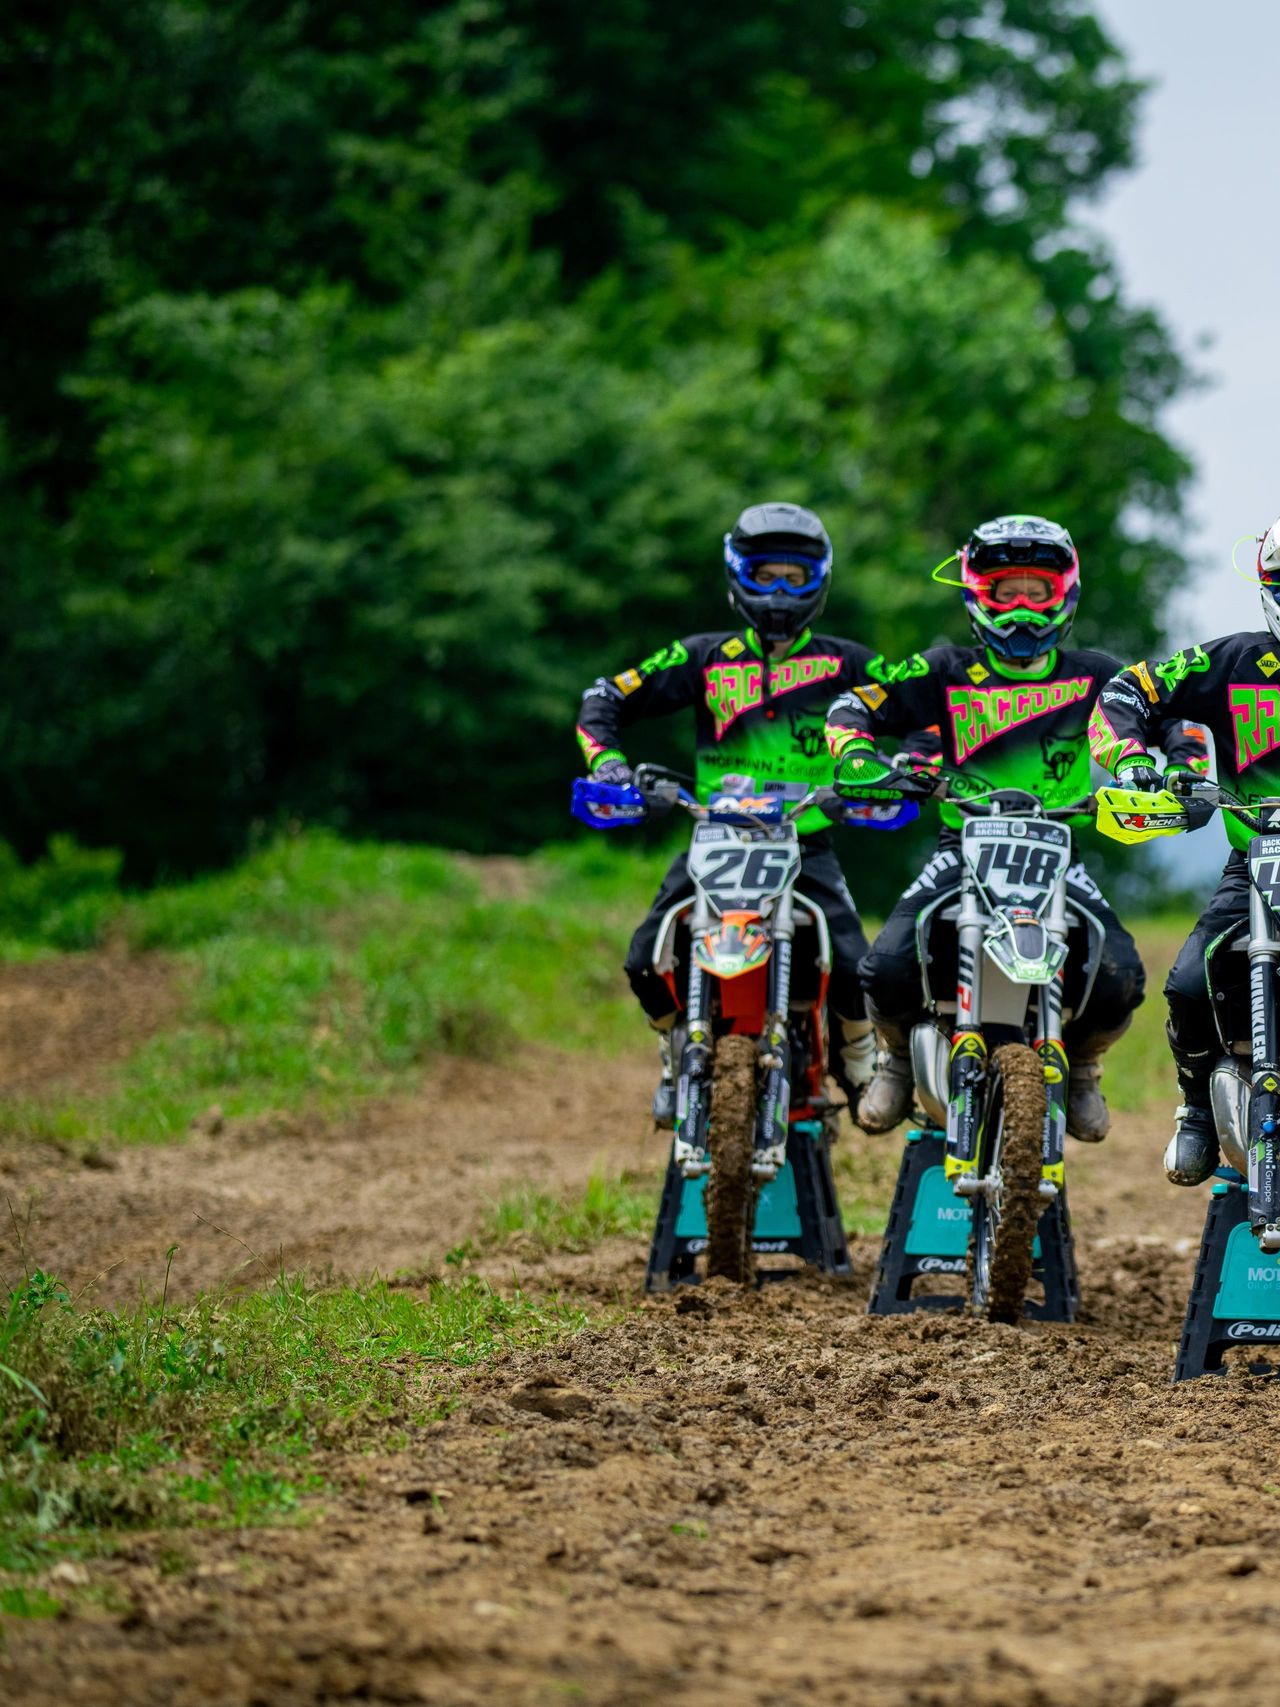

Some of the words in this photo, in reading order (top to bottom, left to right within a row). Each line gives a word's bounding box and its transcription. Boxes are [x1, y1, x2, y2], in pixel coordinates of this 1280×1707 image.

[703, 656, 843, 742] RACCOON
[946, 676, 1094, 766] RACCOON
[839, 786, 904, 800] ACERBIS
[698, 848, 790, 890] 26
[975, 843, 1062, 890] 148
[1250, 965, 1266, 1063] WINKLER
[1265, 1114, 1275, 1163] HANN
[1264, 1170, 1274, 1203] Gruppe
